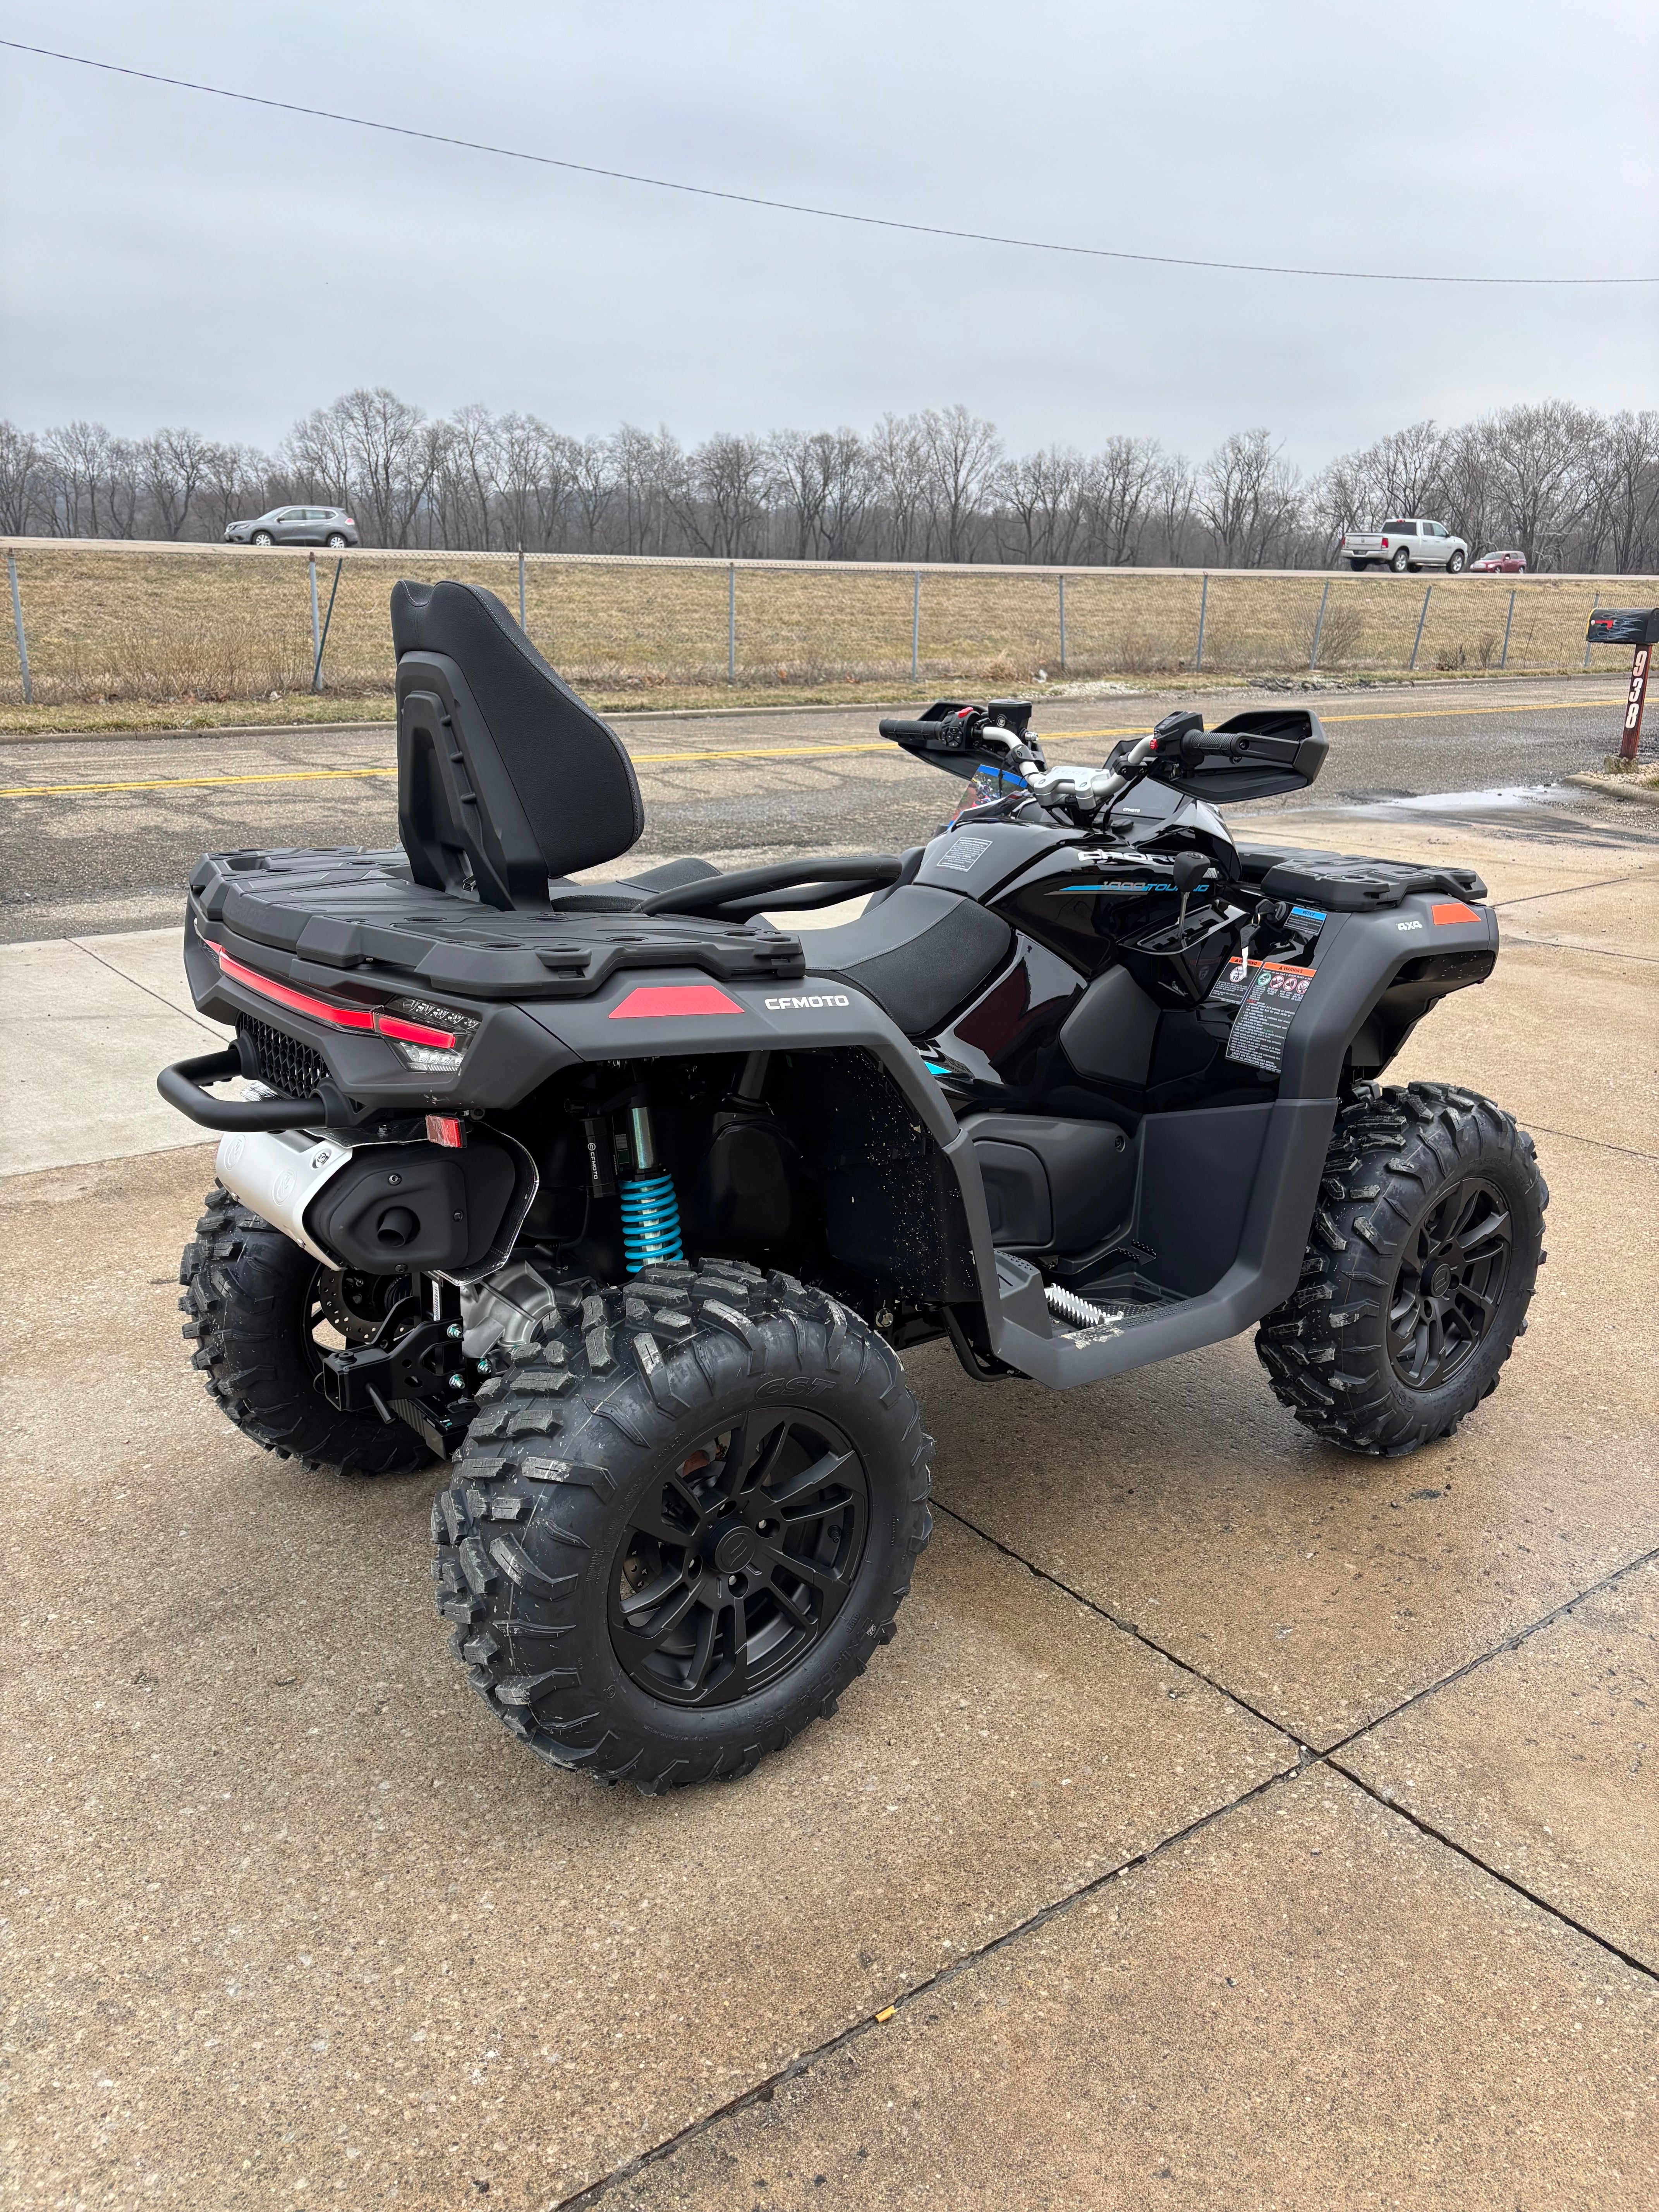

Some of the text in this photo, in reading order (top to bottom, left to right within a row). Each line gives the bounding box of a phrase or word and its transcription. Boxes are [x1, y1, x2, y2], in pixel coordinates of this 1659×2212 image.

[1625, 651, 1647, 728] 938
[1078, 851, 1176, 862] CFOR
[765, 995, 849, 1010] CFMOTO
